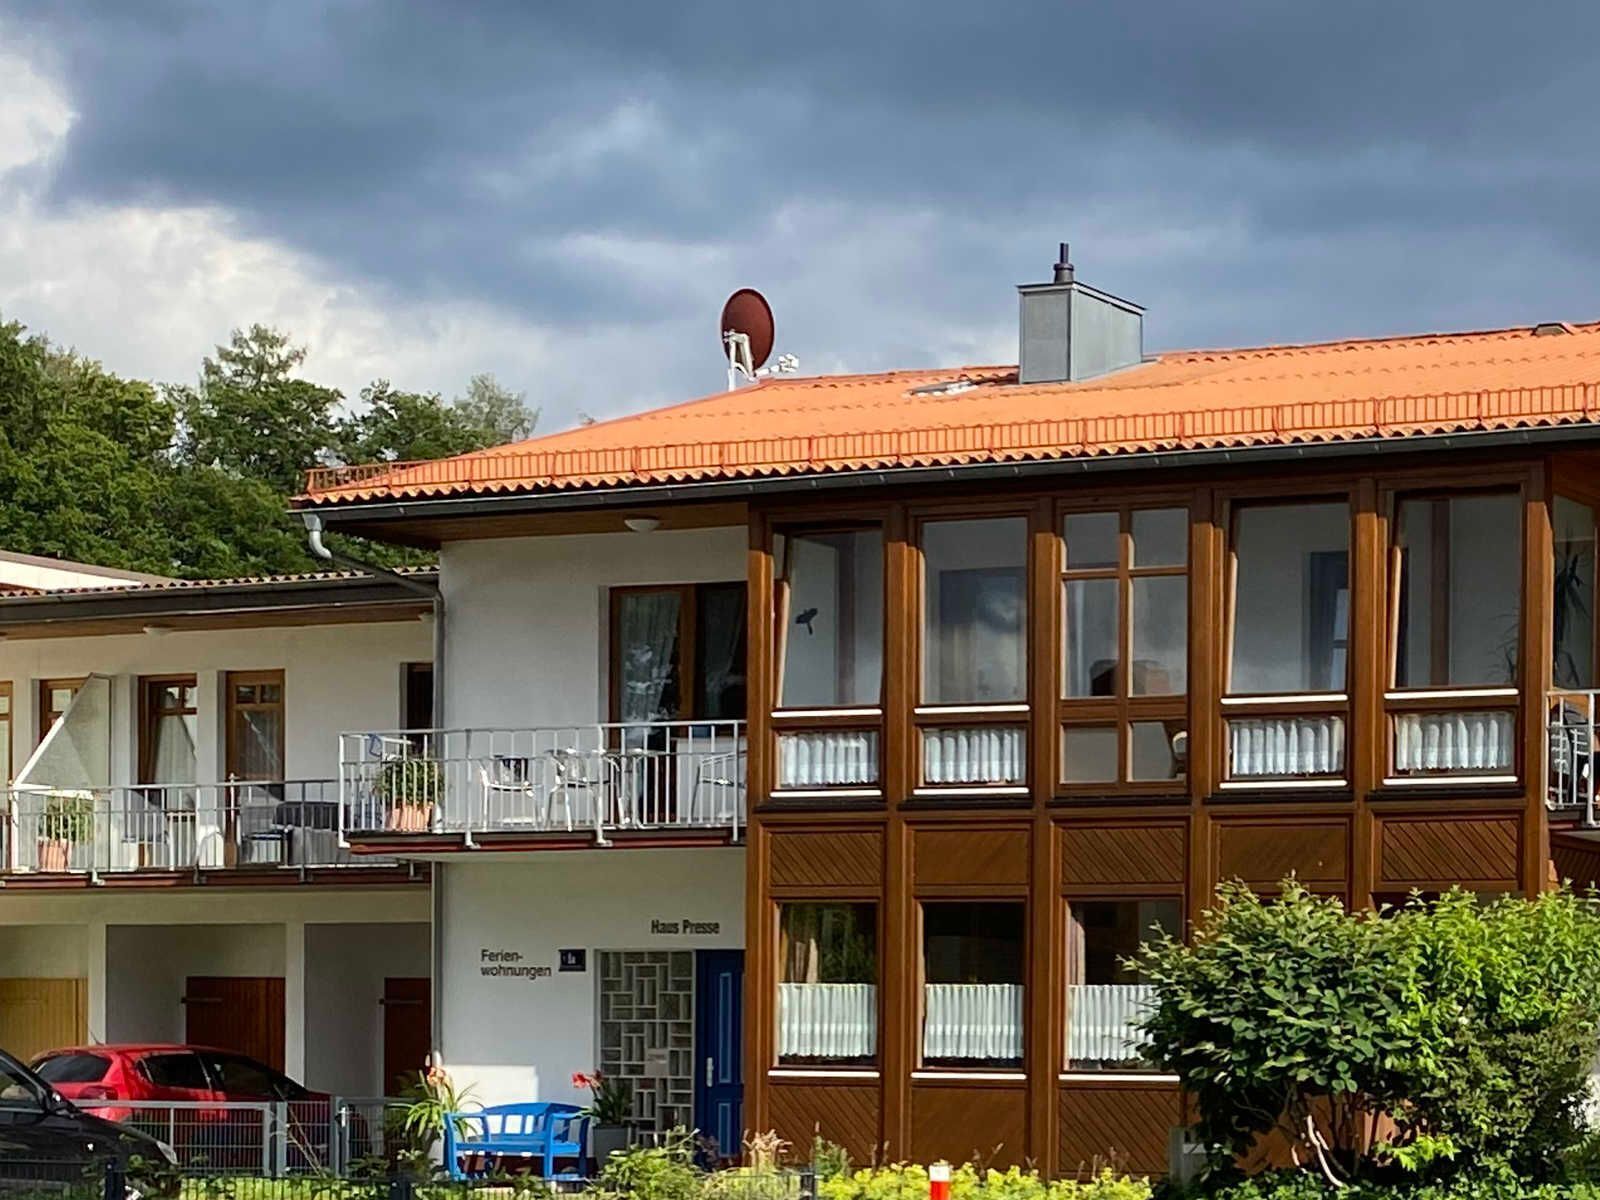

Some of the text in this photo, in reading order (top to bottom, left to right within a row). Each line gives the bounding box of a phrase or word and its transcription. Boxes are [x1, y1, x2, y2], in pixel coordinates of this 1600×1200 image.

[651, 919, 720, 934] Haus Presse
[481, 948, 523, 962] Ferien-
[481, 964, 552, 980] wohnungen
